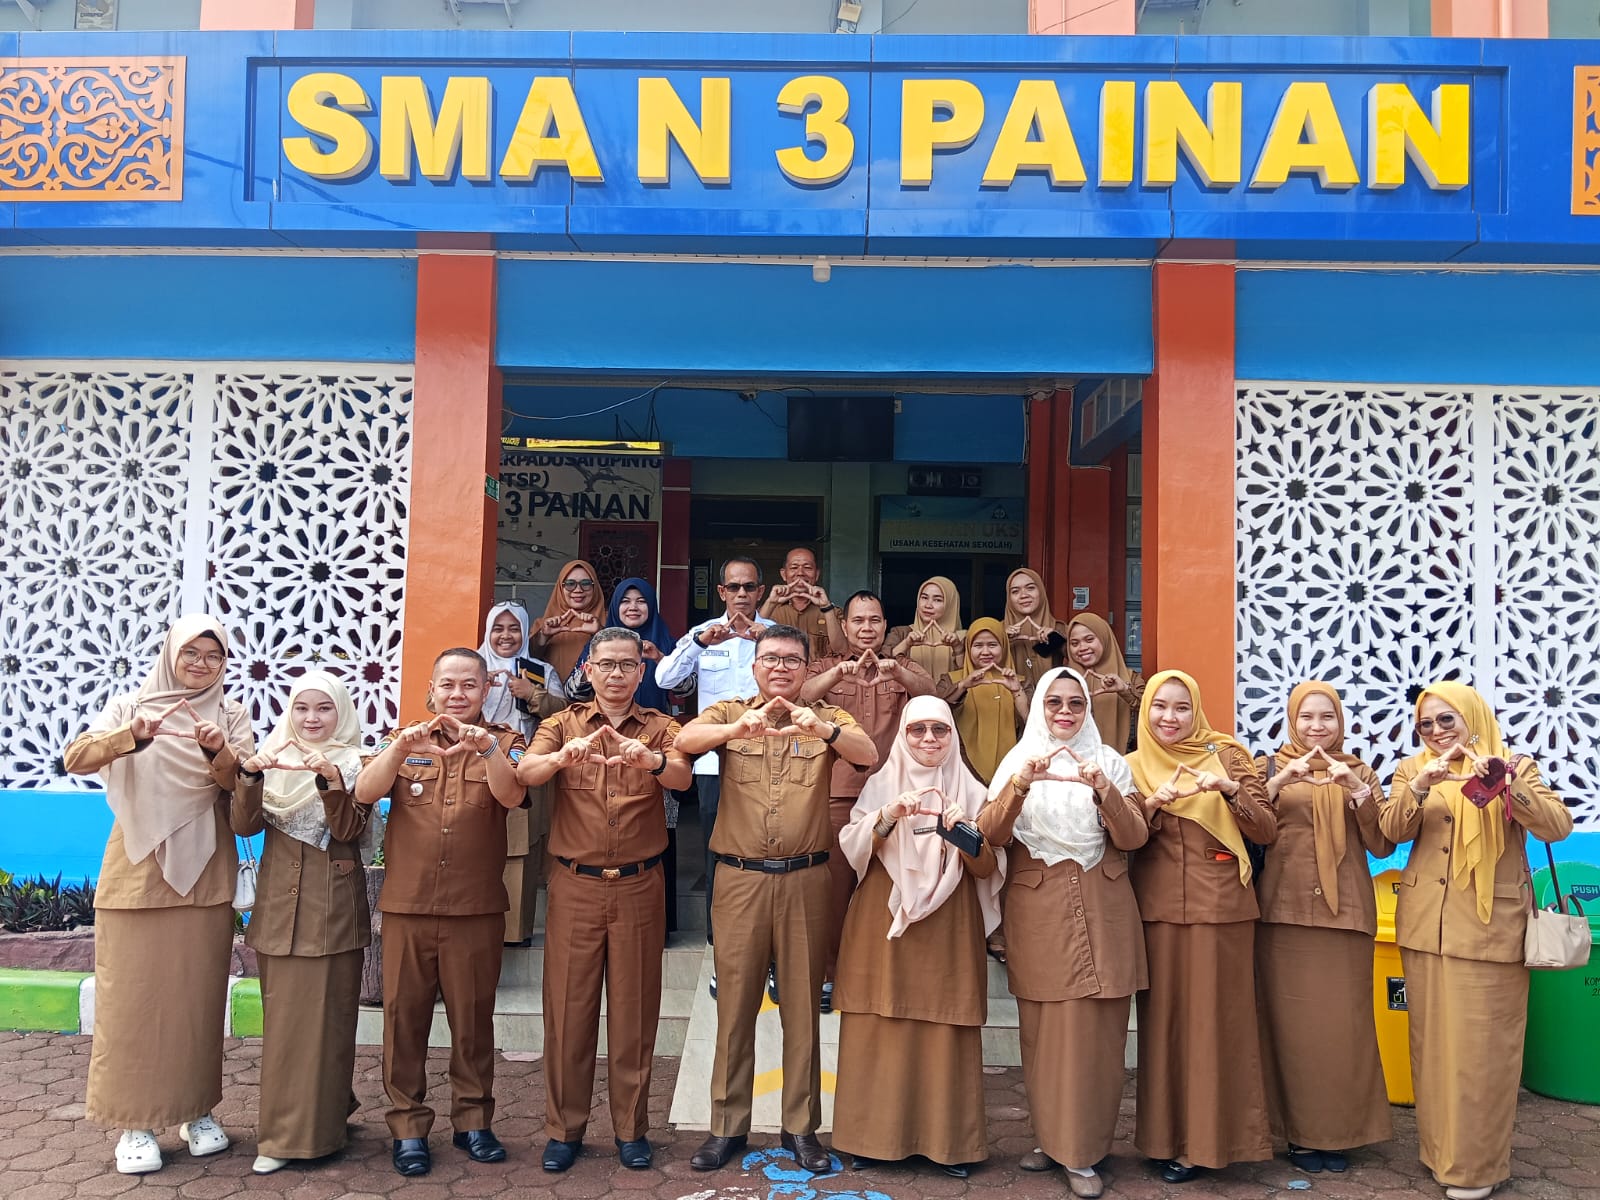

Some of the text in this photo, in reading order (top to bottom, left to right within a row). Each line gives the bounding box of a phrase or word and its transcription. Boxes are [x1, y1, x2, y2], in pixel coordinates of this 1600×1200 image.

[775, 75, 855, 188] 3
[898, 79, 1472, 193] PAINAN
[505, 490, 650, 520] 3 PAINAN
[923, 539, 970, 549] KESEHATAN
[972, 540, 1013, 550] SEKOLAH)
[1572, 886, 1599, 894] PUSH
